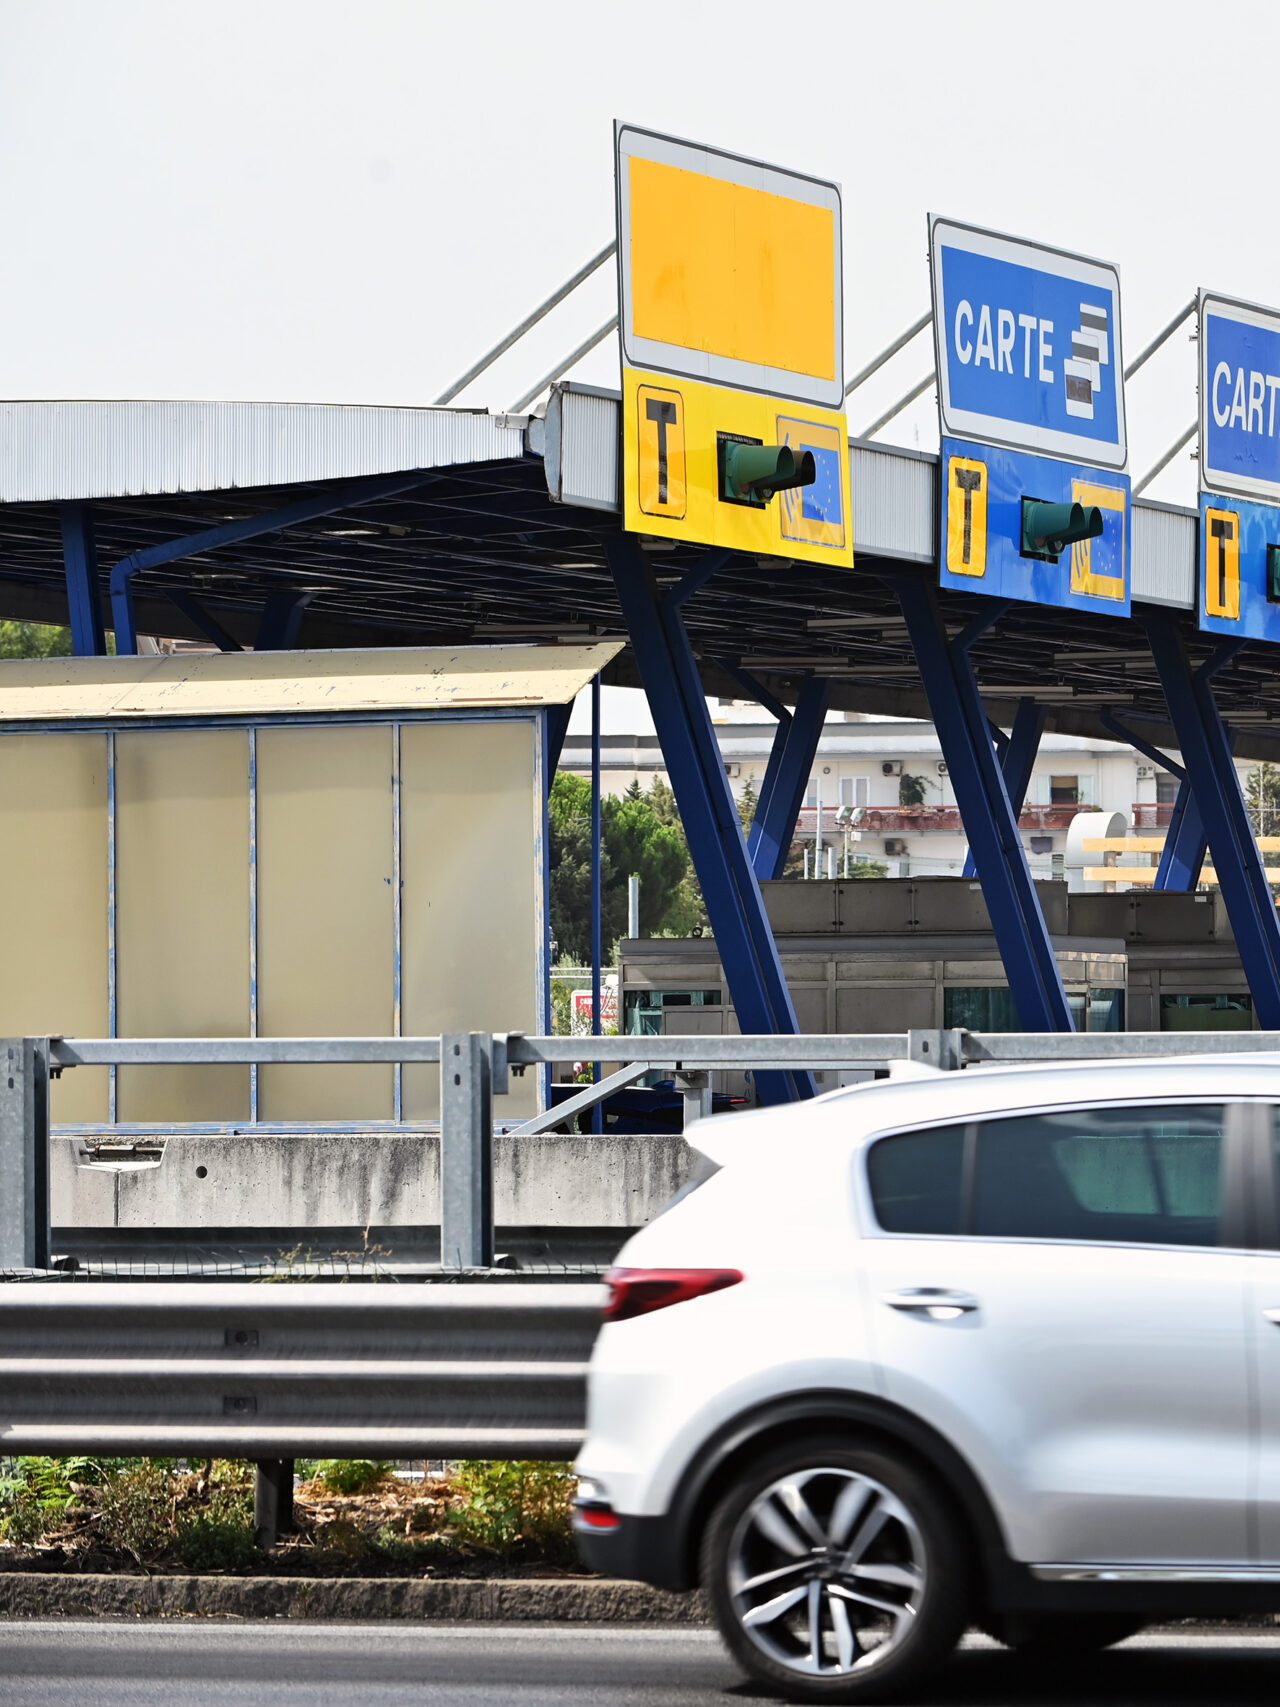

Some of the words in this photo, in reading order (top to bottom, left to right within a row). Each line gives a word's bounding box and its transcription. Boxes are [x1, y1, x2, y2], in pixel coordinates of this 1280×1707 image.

[954, 299, 1055, 384] CARTE
[646, 397, 677, 505] T
[954, 467, 982, 565] T
[1211, 517, 1234, 608] T
